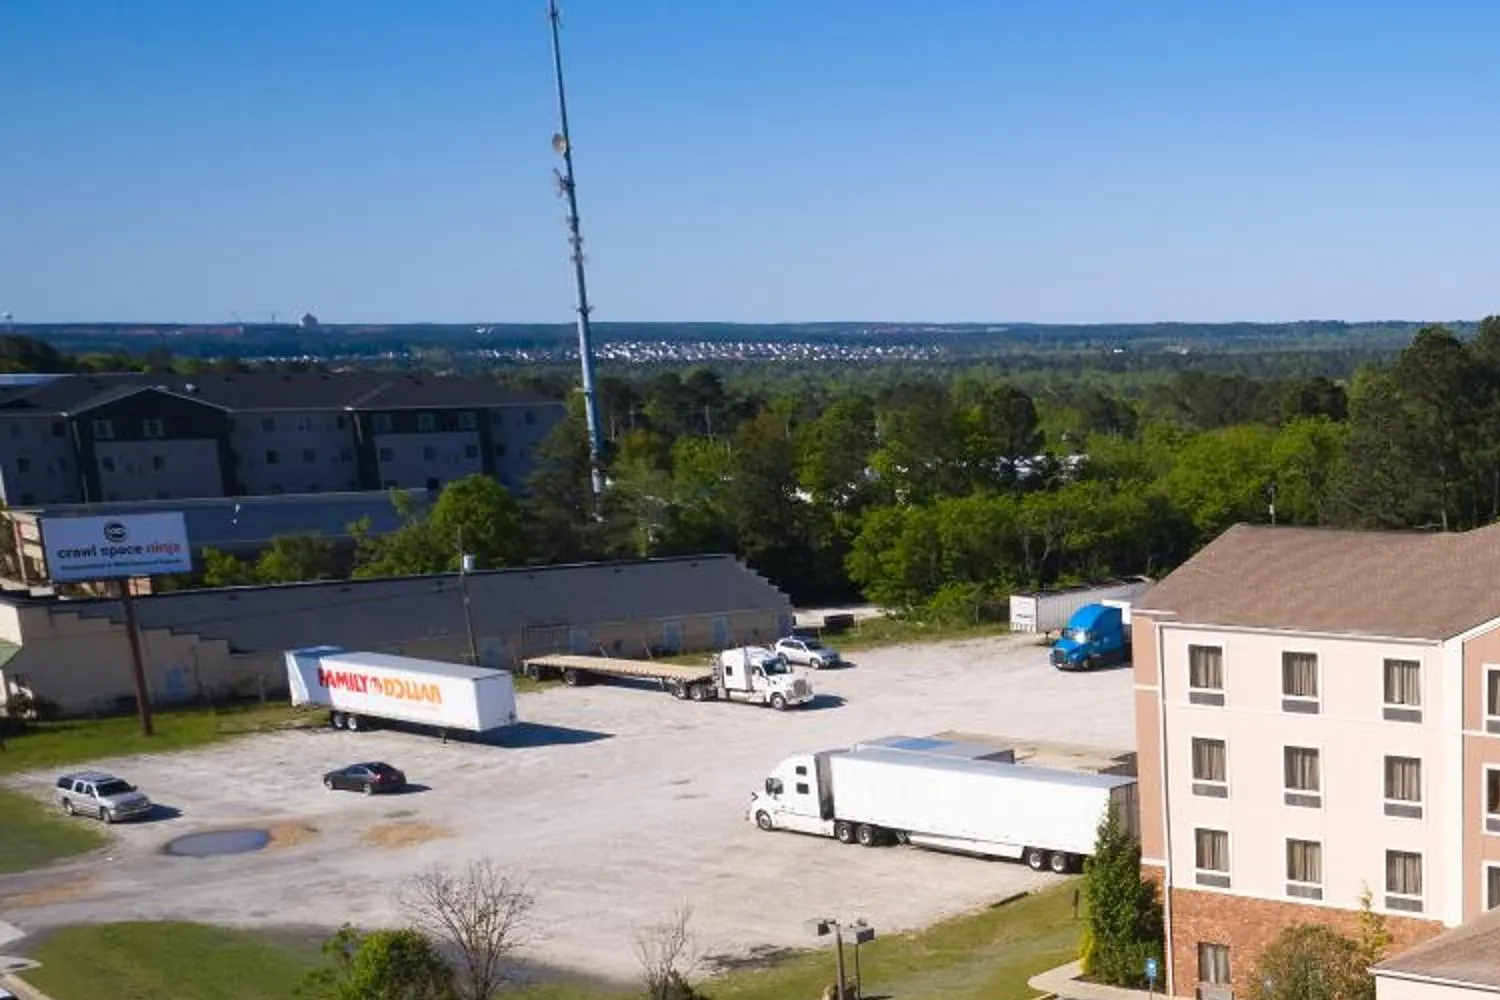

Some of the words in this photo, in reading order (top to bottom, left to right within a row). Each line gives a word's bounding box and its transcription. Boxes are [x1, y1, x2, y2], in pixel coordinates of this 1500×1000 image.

[57, 543, 97, 559] crawl
[101, 544, 144, 559] space
[318, 667, 369, 693] FAMILY
